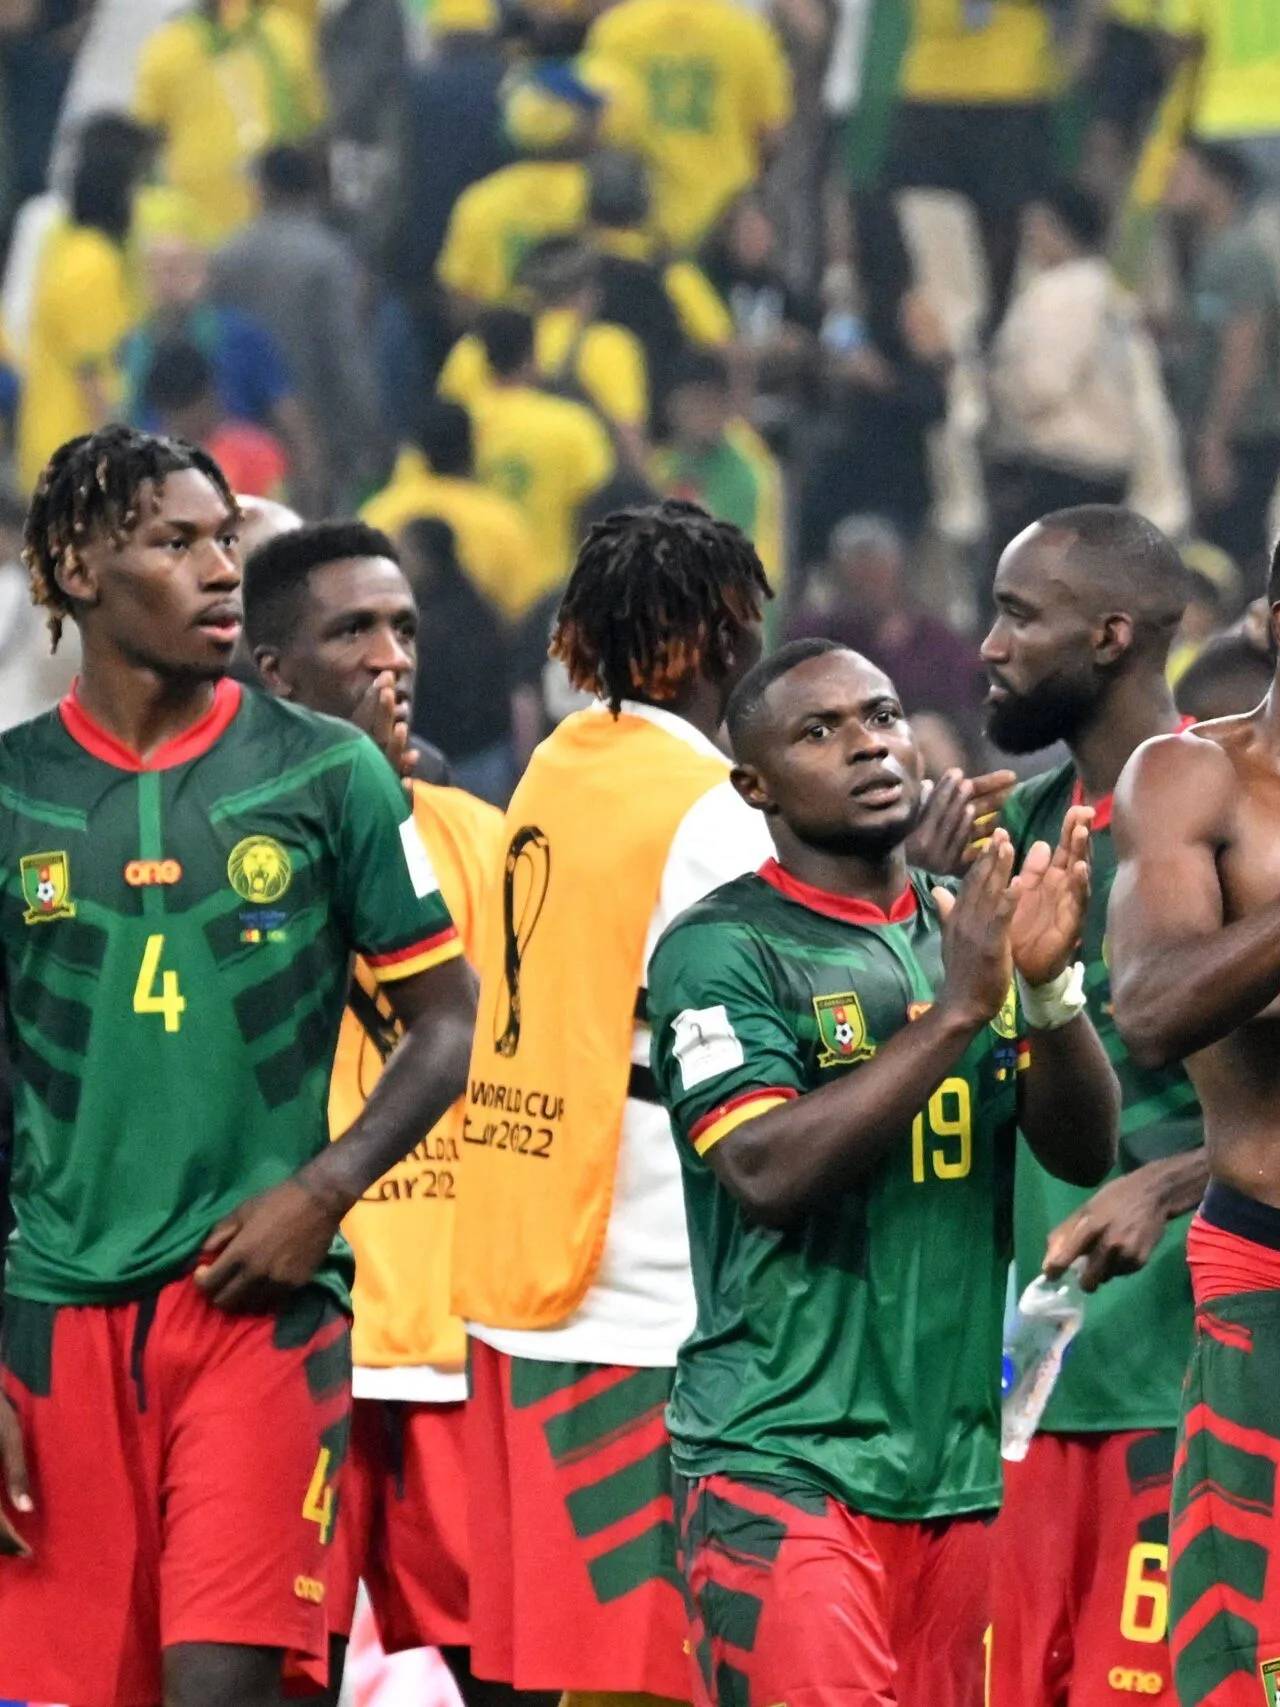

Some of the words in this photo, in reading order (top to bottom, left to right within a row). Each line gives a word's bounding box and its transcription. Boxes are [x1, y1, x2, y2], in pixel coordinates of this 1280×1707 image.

[133, 934, 186, 1032] 4
[470, 1080, 522, 1114] WORLD
[911, 1077, 972, 1183] 19
[302, 1447, 333, 1546] 4
[1120, 1542, 1168, 1643] 6
[1108, 1666, 1163, 1695] one
